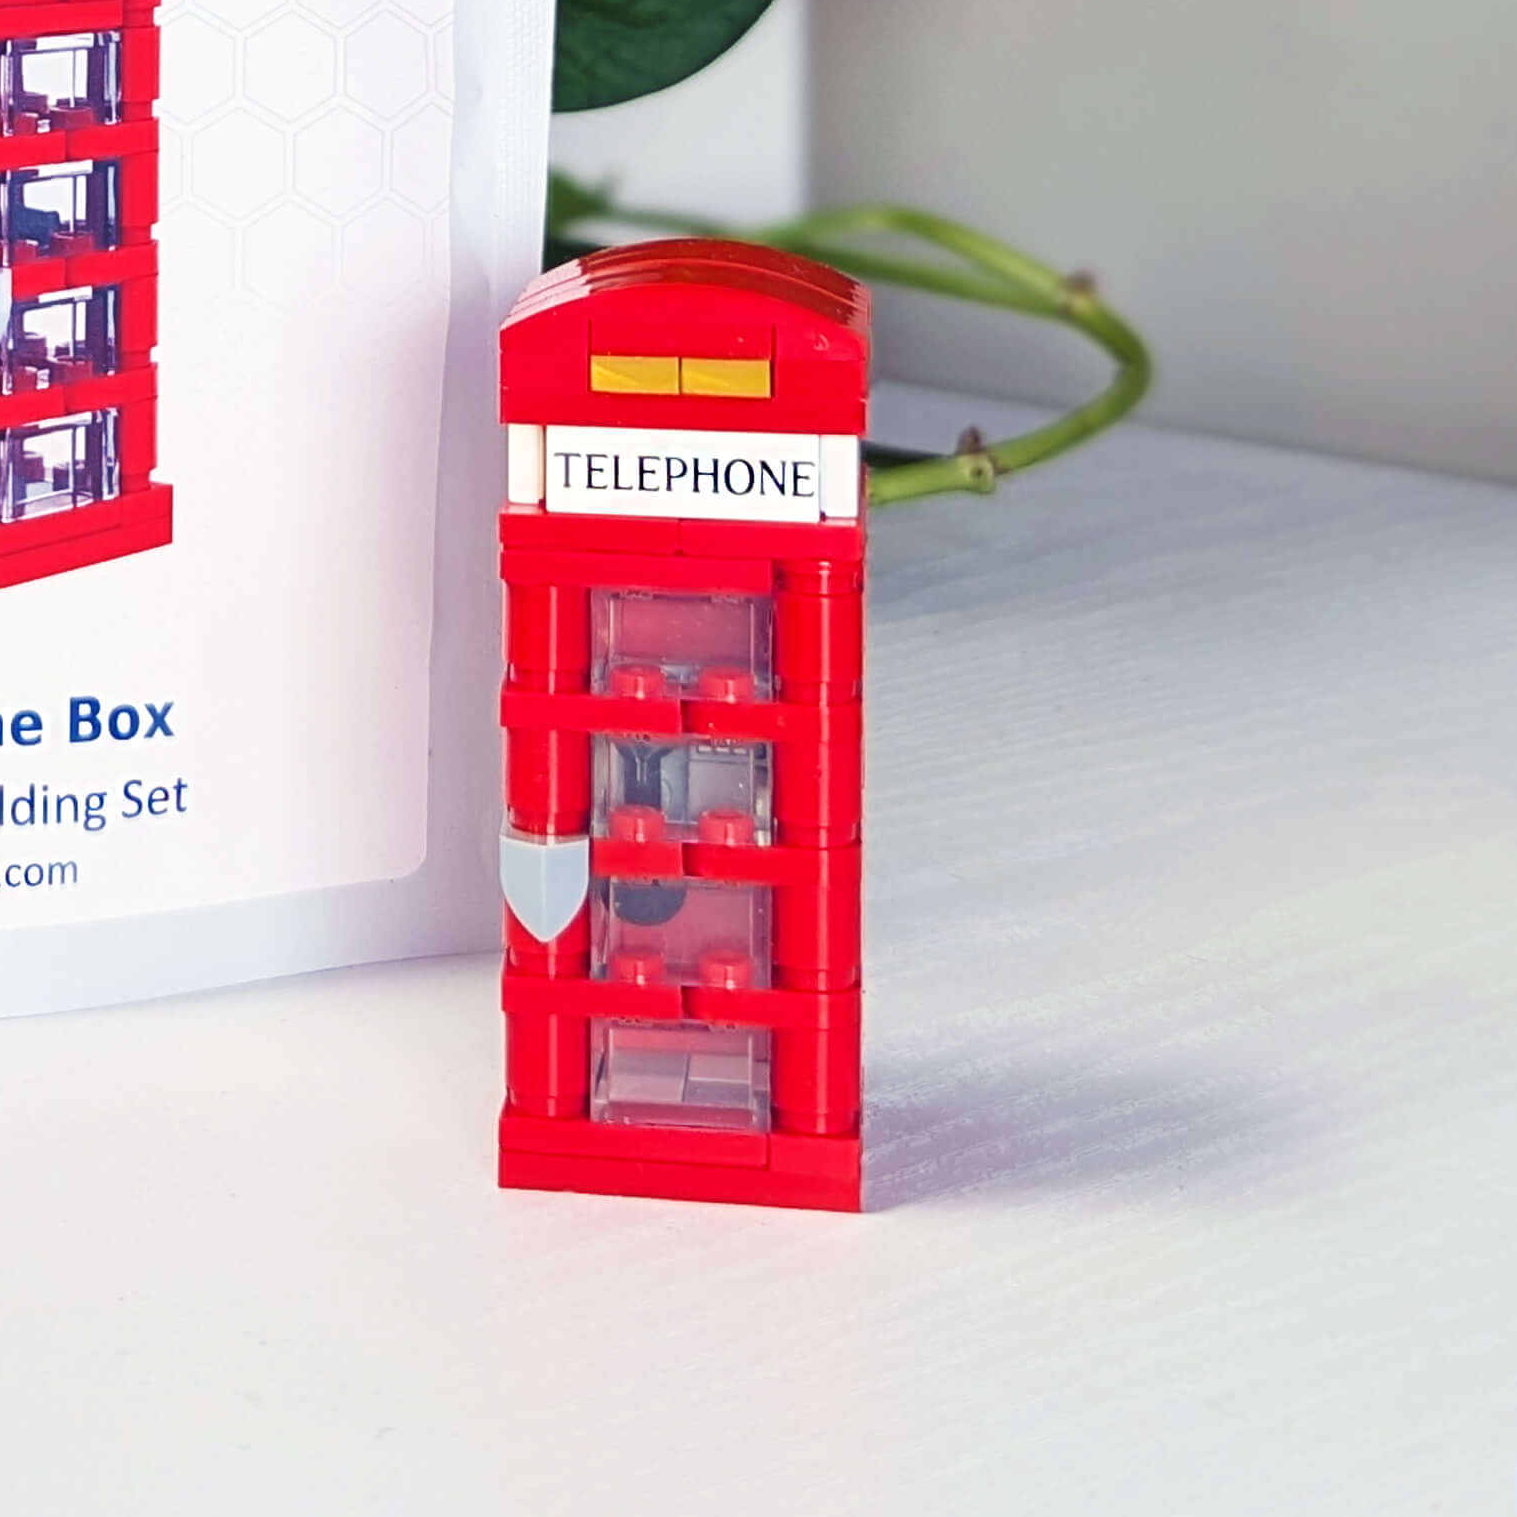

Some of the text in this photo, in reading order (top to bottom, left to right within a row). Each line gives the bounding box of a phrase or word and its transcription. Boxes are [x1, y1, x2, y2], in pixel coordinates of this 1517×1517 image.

[553, 452, 816, 498] TELEPHONE
[68, 695, 175, 744] Box
[121, 777, 189, 820] Set
